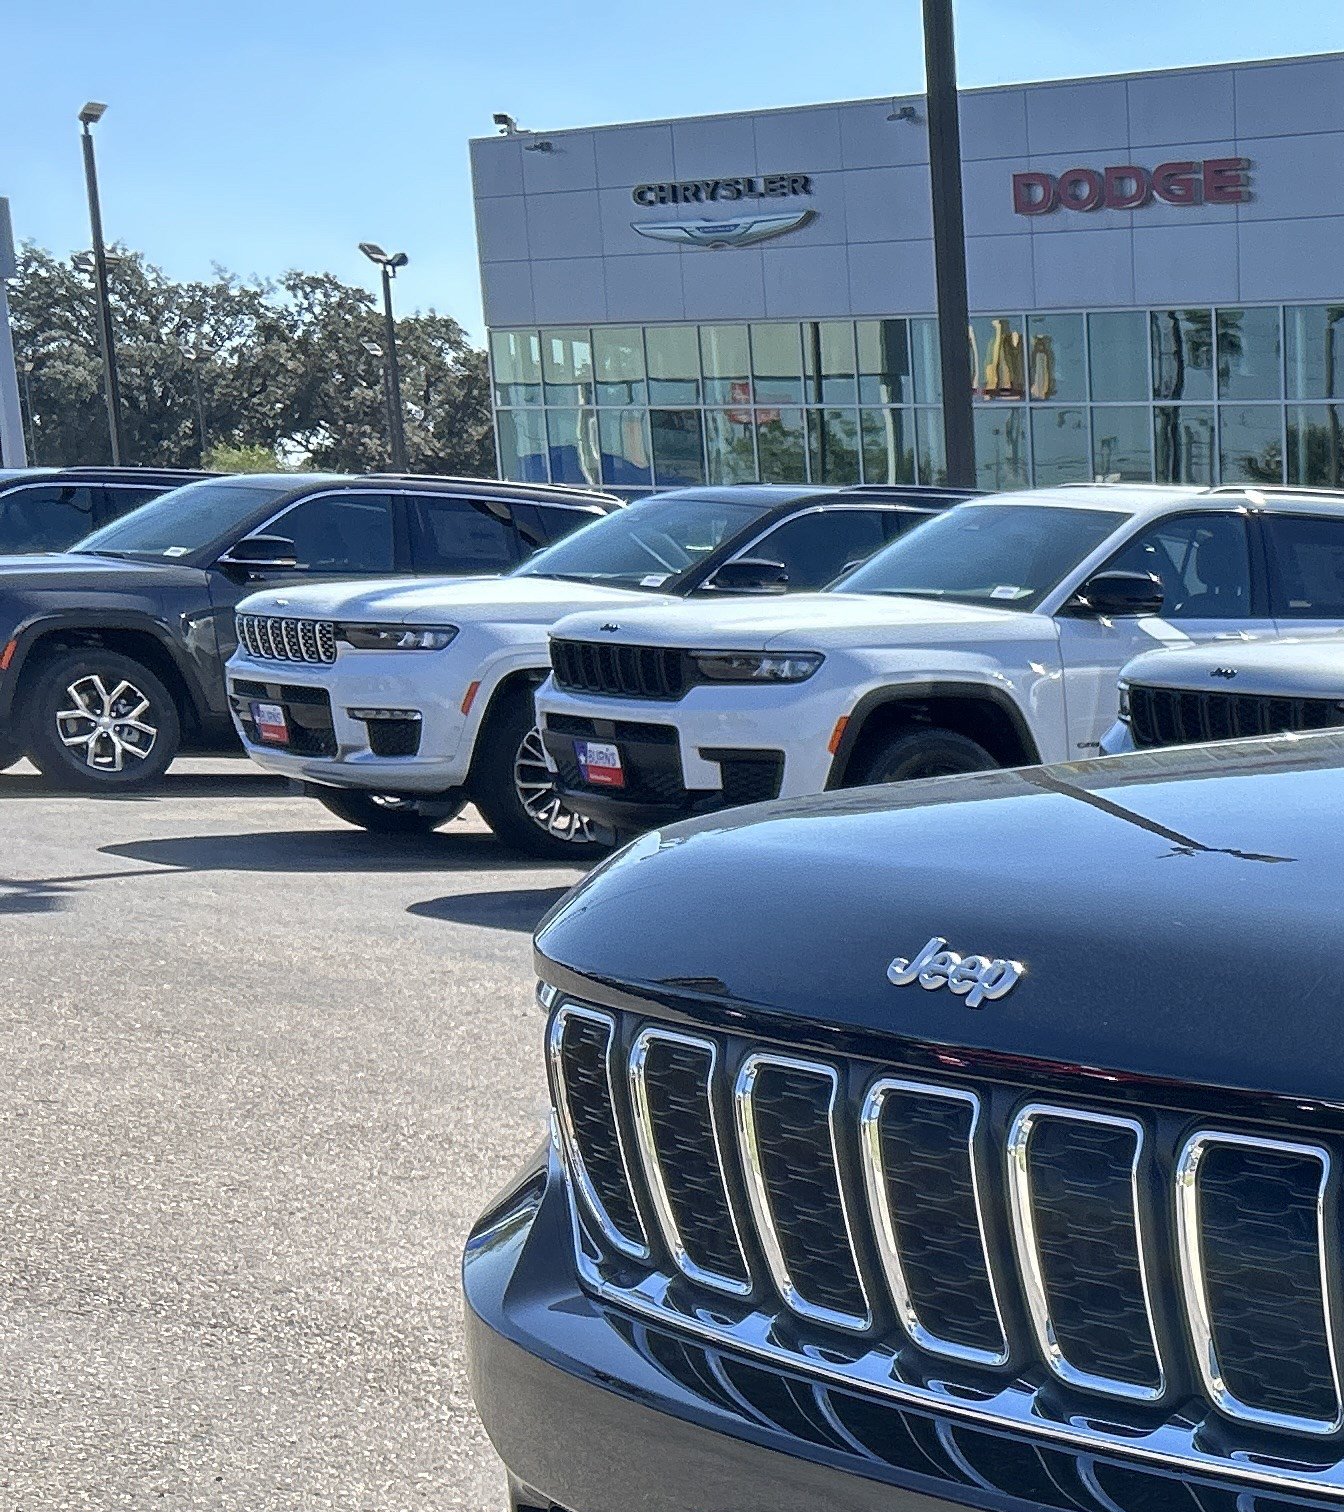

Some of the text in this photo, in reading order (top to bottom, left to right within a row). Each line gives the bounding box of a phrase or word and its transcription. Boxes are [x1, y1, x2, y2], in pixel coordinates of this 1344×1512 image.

[632, 173, 813, 207] CHRYSLER
[1012, 157, 1252, 216] DODGE
[886, 936, 1025, 1008] Jeep
